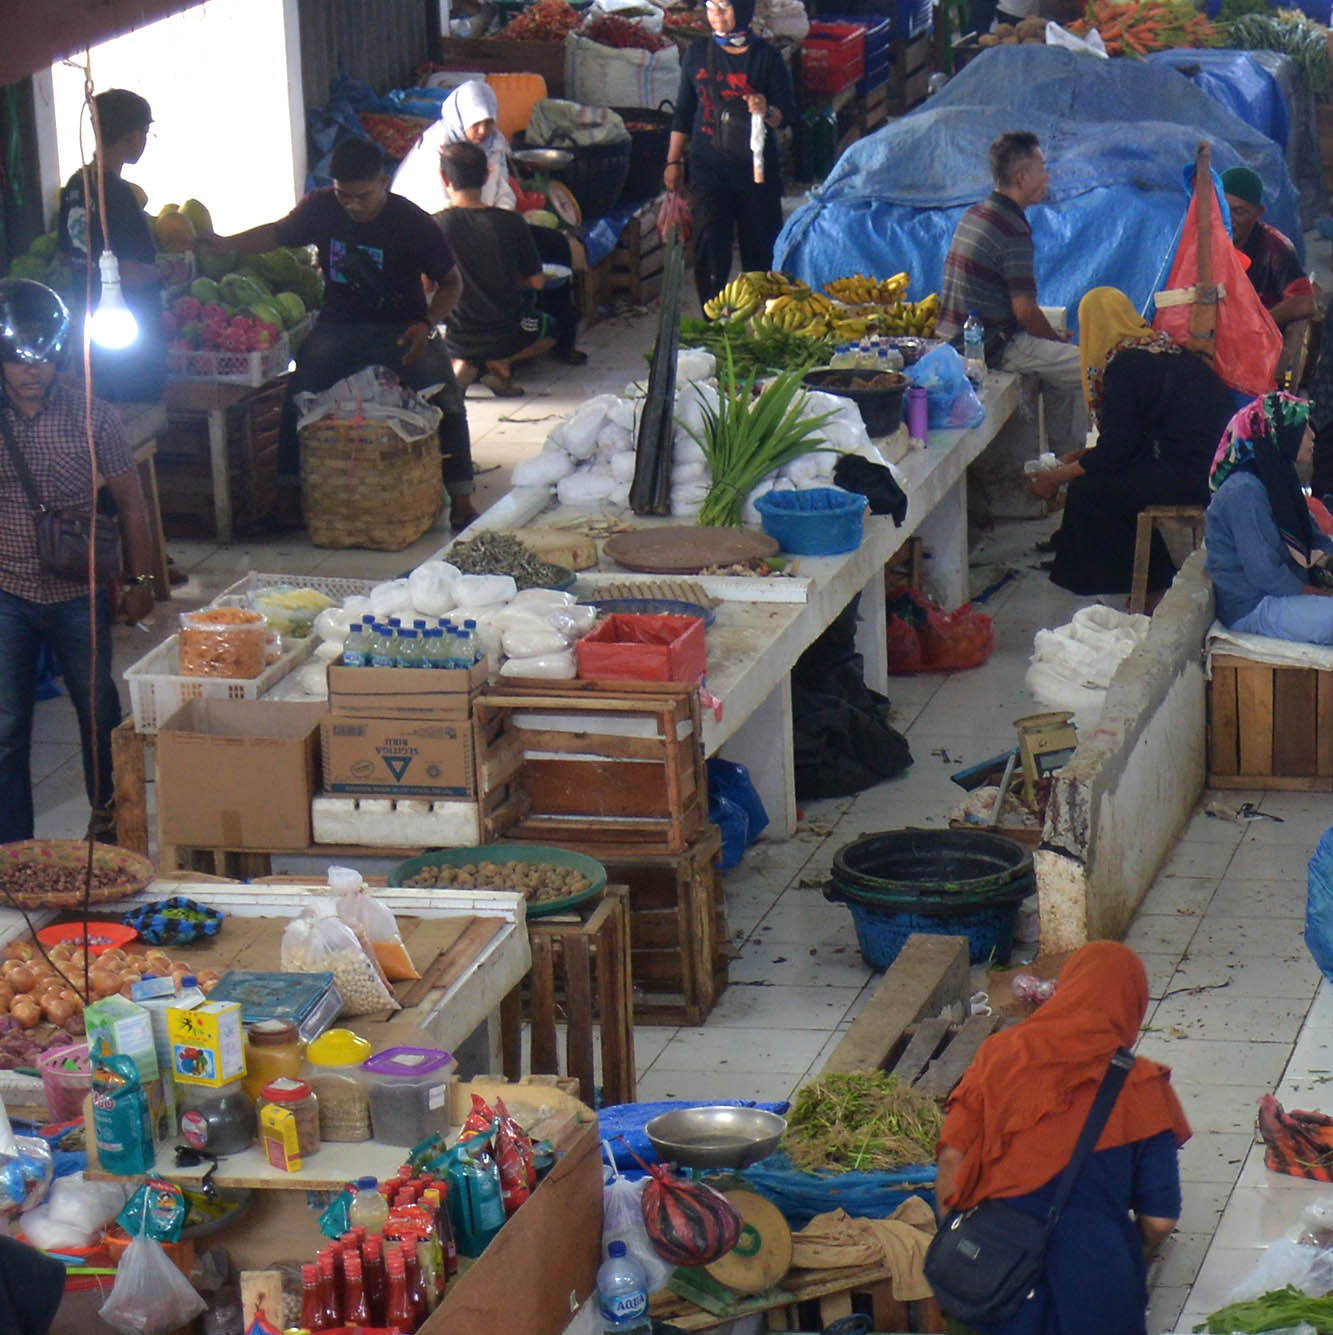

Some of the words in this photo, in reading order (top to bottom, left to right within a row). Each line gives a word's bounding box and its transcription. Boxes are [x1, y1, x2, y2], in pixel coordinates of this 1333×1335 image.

[385, 738, 408, 746] BIRU
[375, 746, 419, 756] SEGITIGA
[617, 1295, 644, 1310] AQUA
